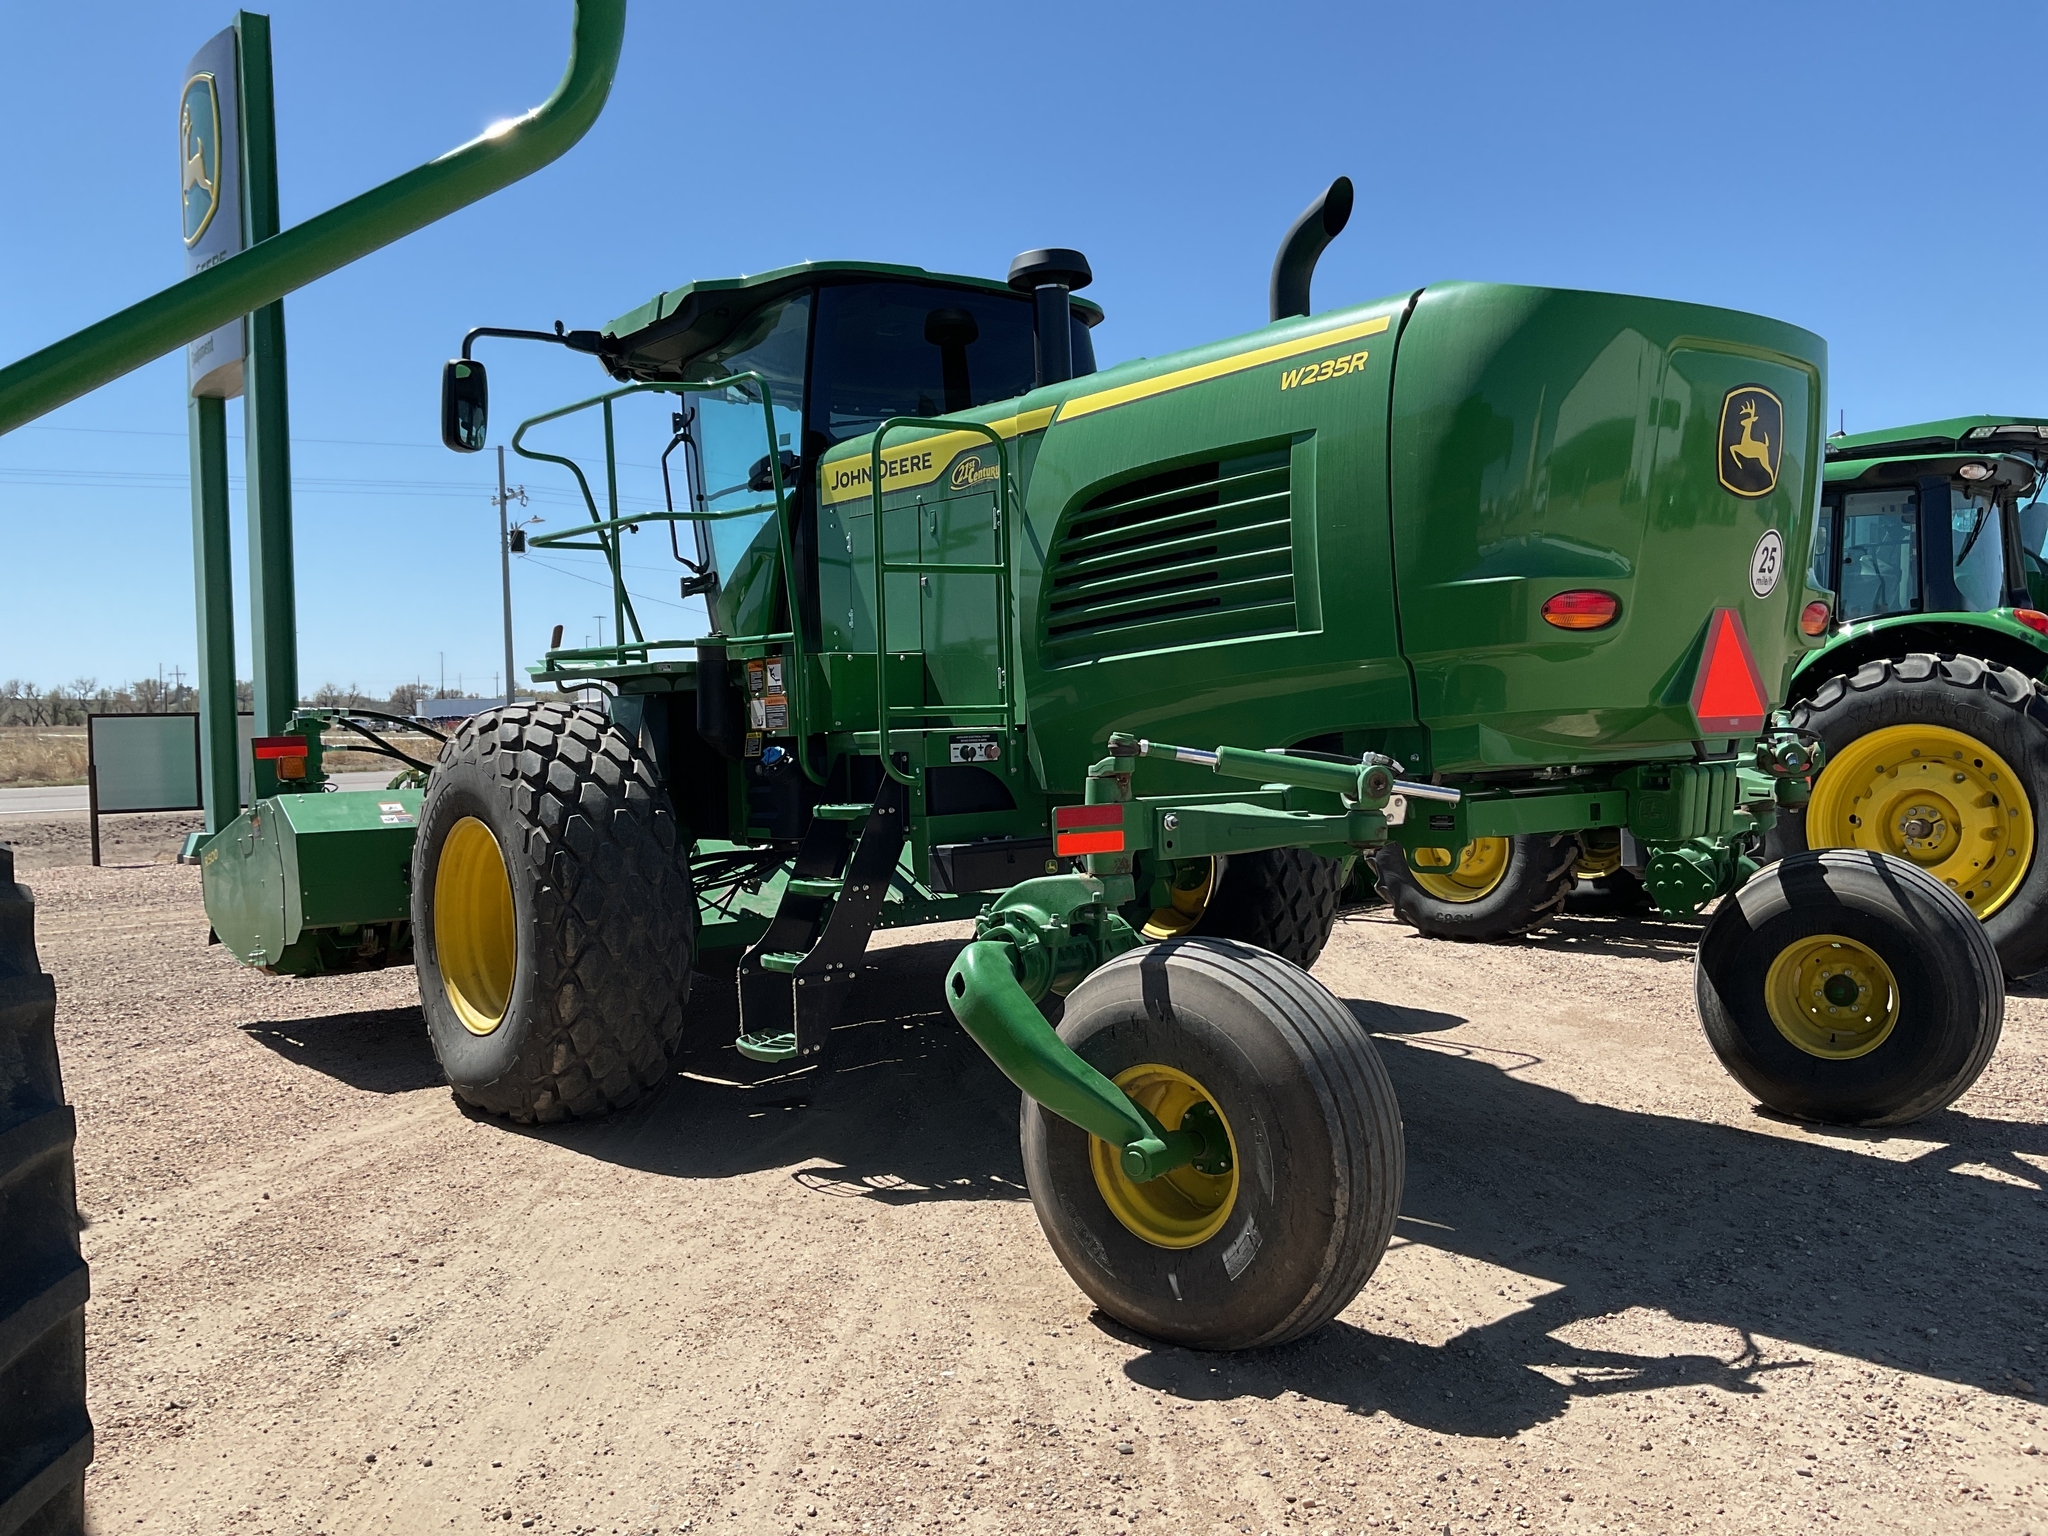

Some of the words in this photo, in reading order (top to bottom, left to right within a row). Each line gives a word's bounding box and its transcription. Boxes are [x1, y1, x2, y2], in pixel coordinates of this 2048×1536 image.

[1280, 350, 1369, 391] W235R
[831, 466, 872, 491] JOHN
[878, 452, 932, 479] DEERE
[1758, 546, 1777, 574] 25
